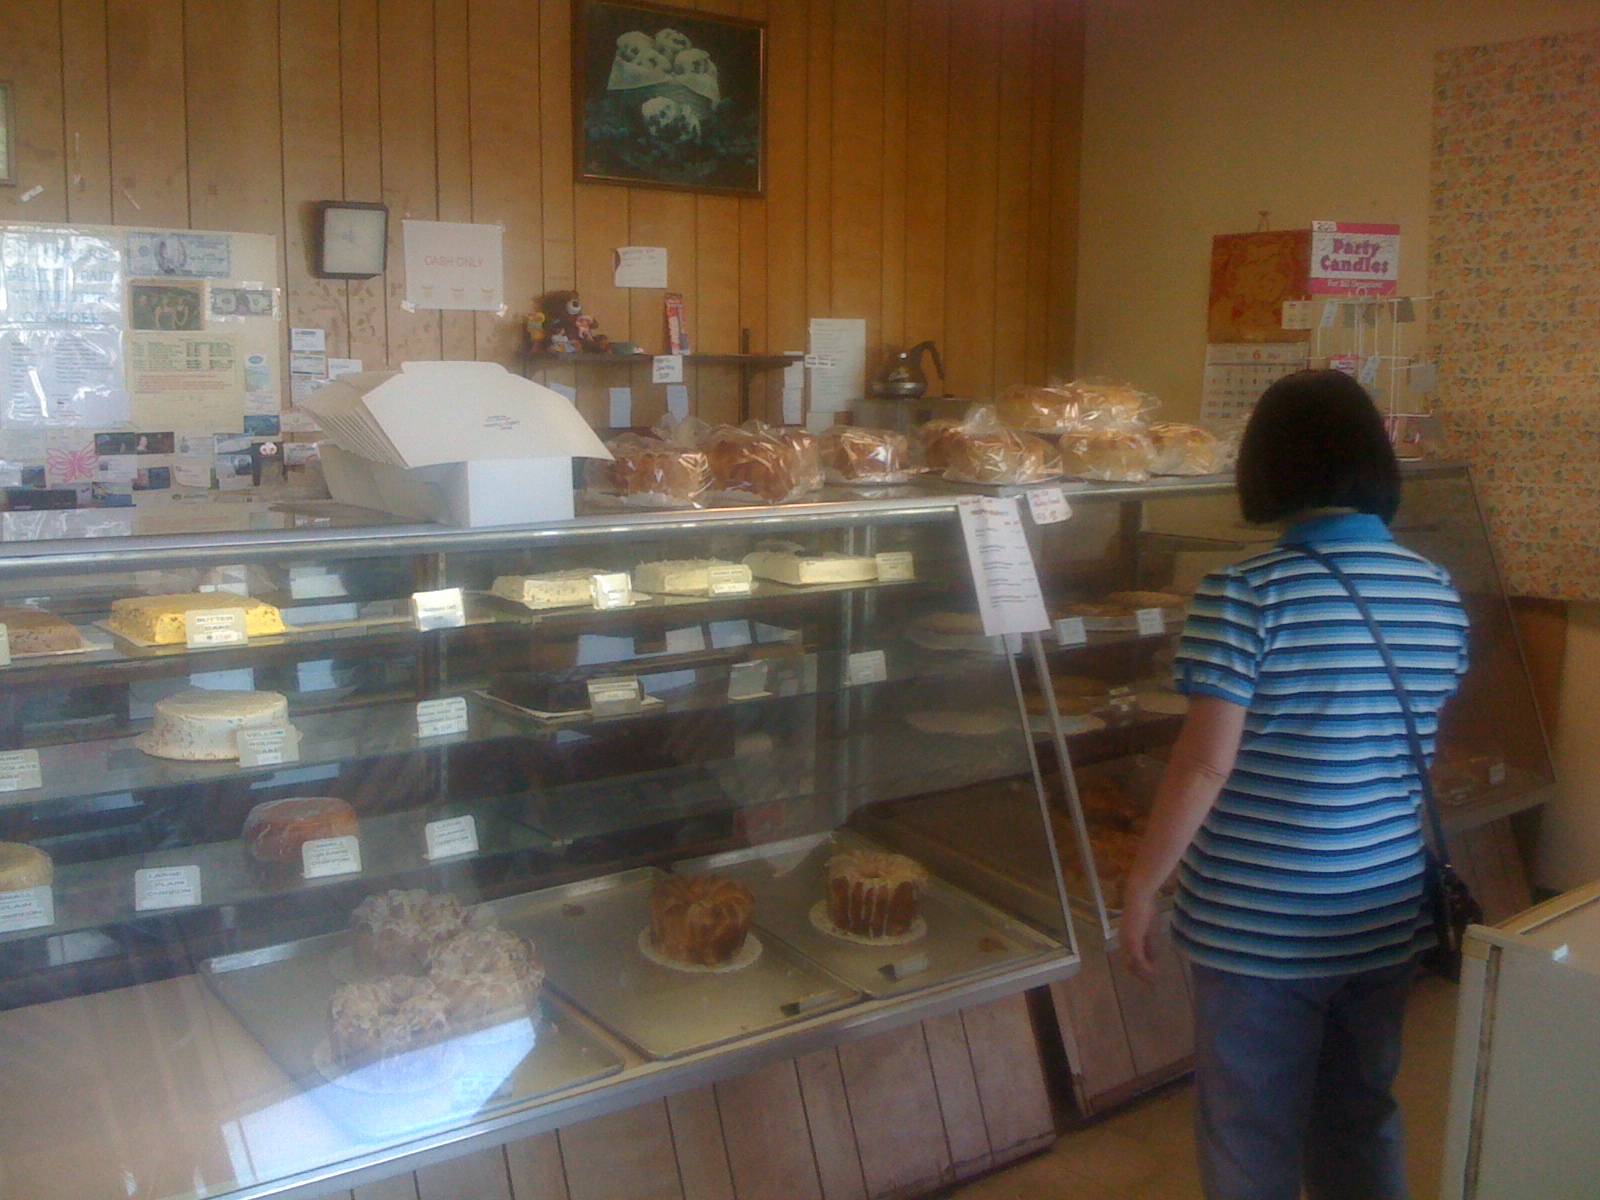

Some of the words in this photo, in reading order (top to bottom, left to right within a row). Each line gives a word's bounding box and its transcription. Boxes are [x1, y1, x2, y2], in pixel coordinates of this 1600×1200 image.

[1332, 238, 1381, 258] Party
[424, 255, 453, 266] CASH
[456, 256, 484, 267] ONLY
[1320, 254, 1389, 274] Candles
